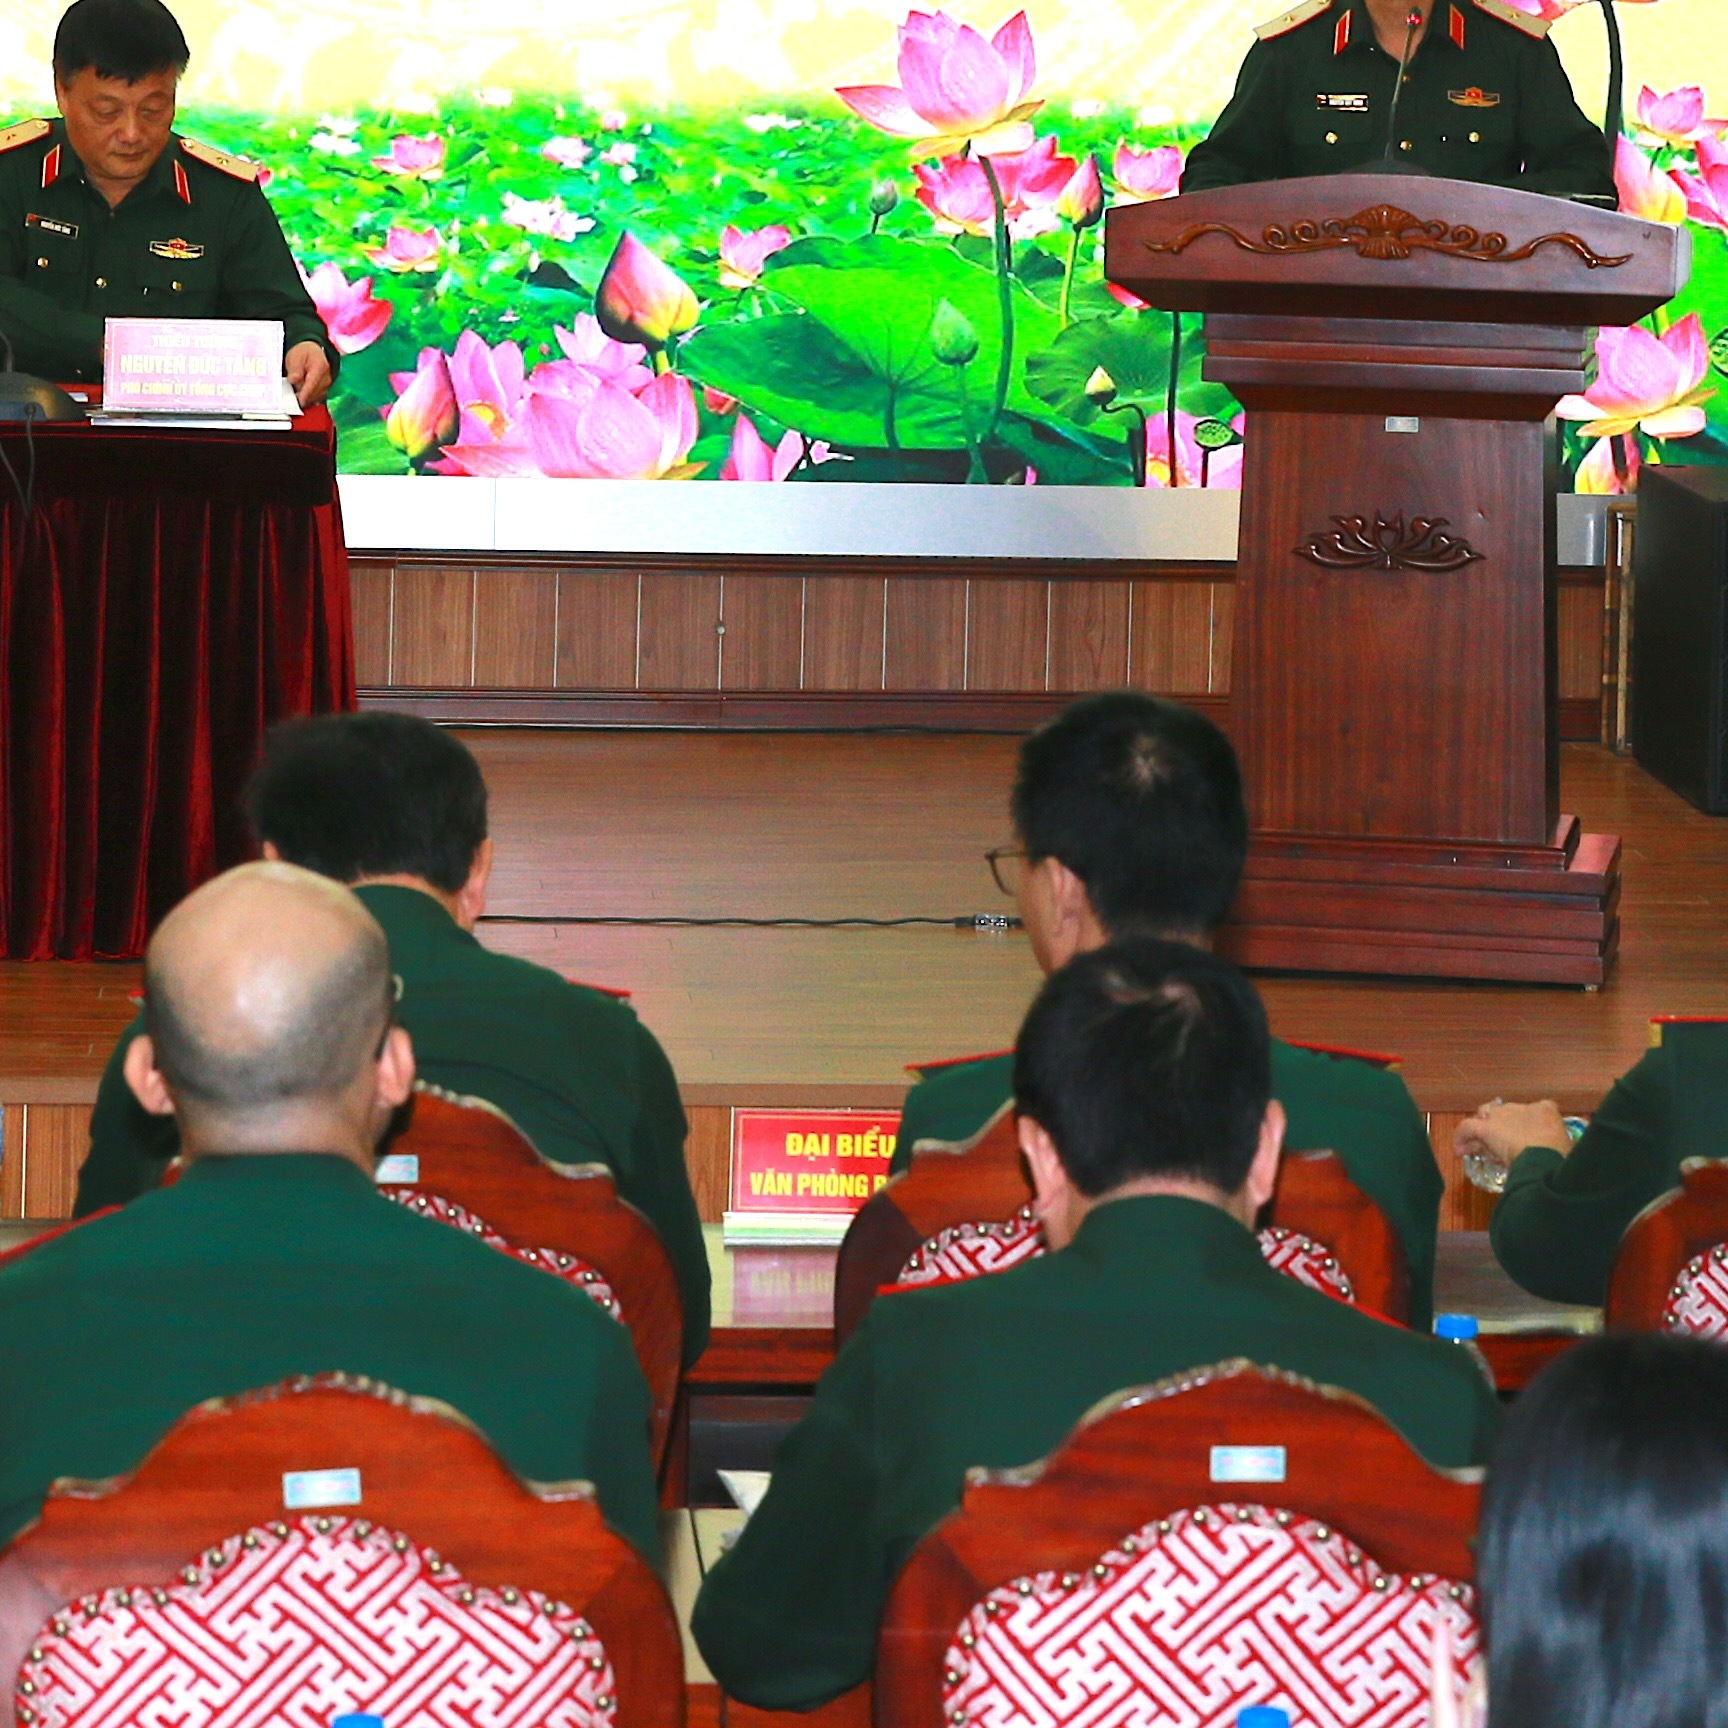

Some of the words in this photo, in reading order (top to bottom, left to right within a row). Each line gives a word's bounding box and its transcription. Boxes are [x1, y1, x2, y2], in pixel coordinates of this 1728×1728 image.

[785, 1132, 831, 1162] ĐẠI
[835, 1125, 898, 1159] BIỂU
[749, 1167, 793, 1196] VĂN
[797, 1167, 869, 1198] PHÒNG
